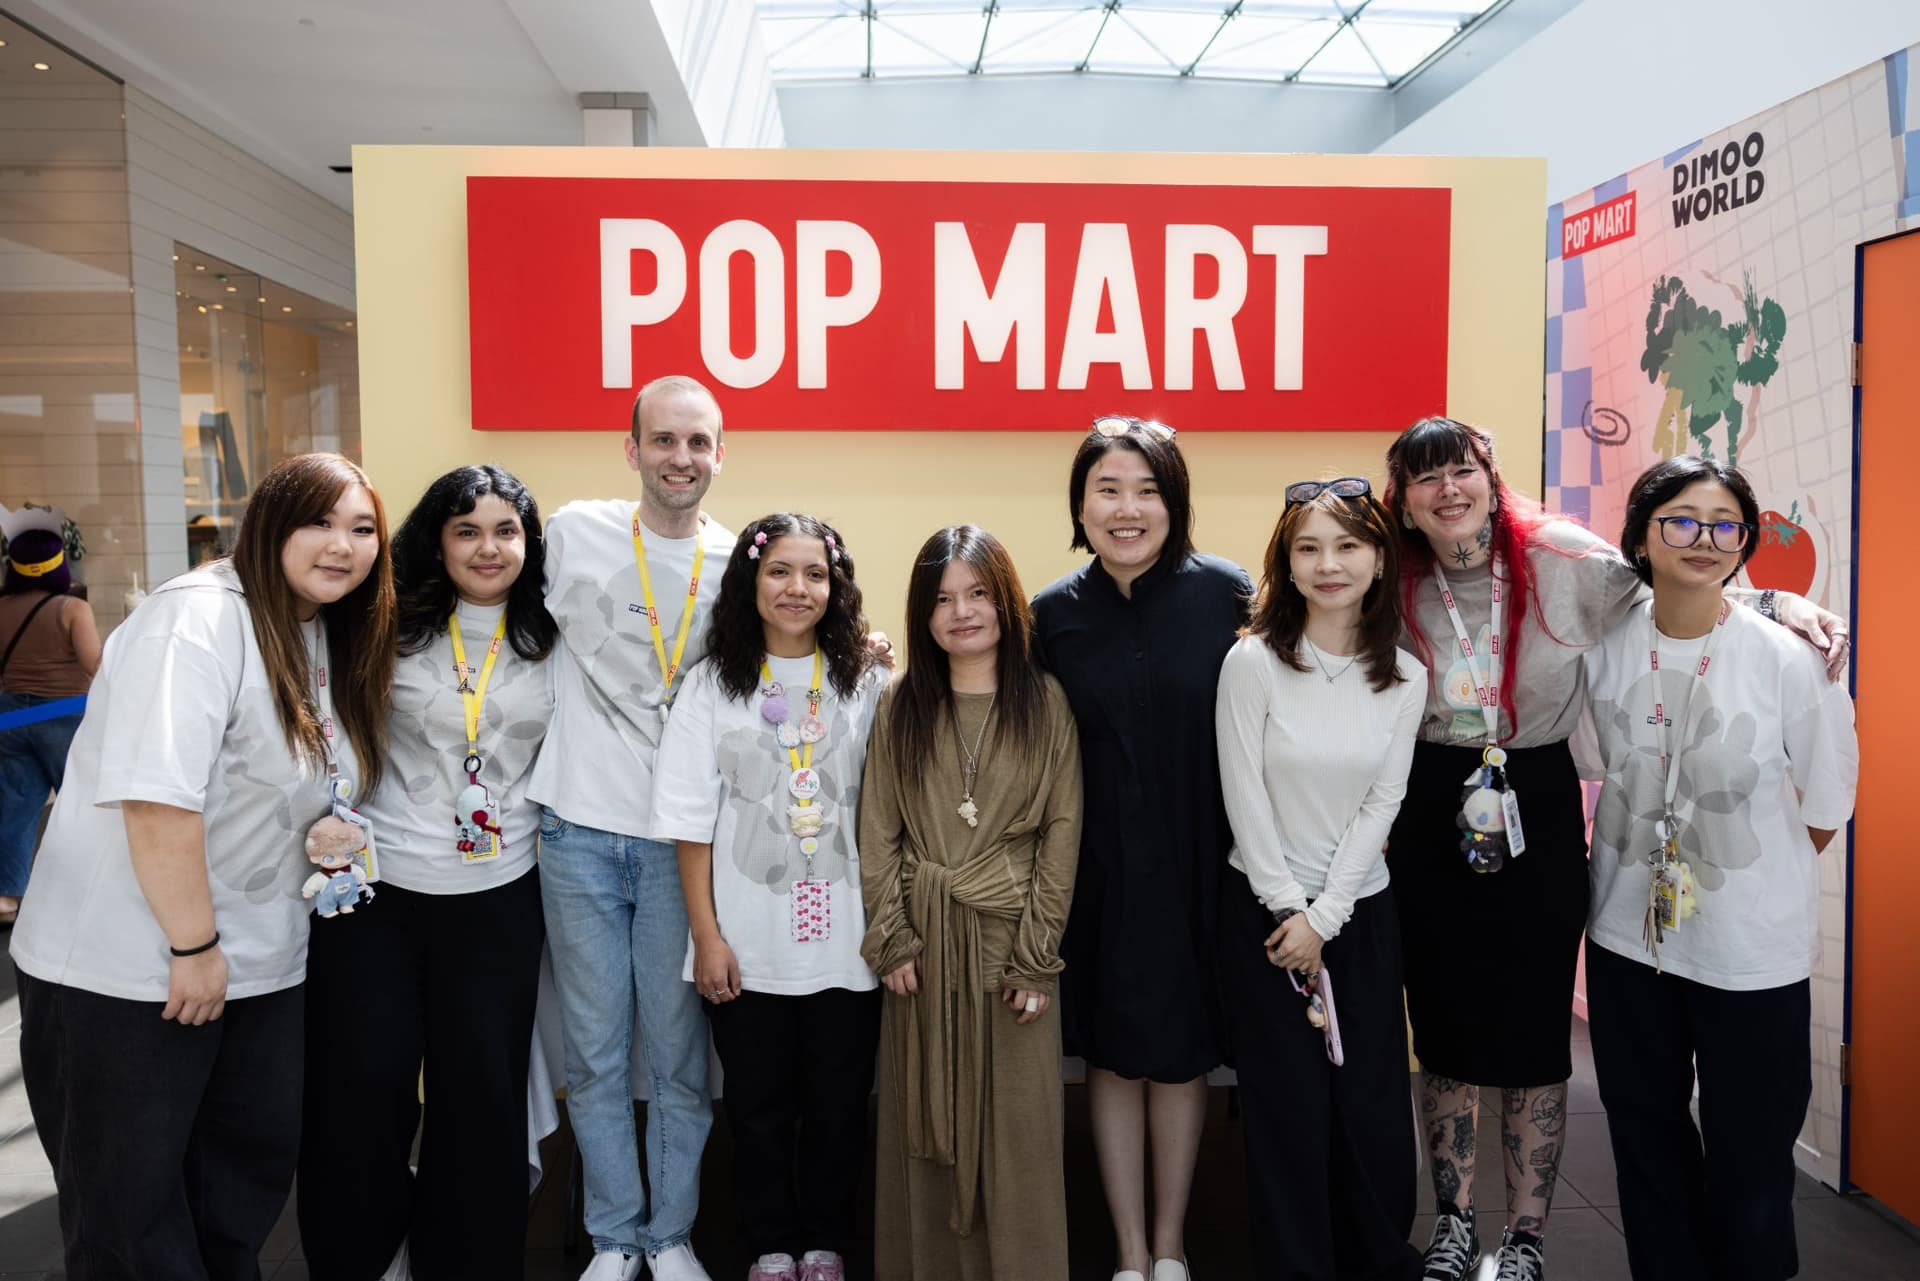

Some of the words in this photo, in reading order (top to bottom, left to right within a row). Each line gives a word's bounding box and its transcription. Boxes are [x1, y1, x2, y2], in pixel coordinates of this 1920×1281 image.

[1673, 131, 1764, 195] DIMOO
[1565, 216, 1590, 253] POP
[1593, 198, 1633, 243] MART
[1672, 170, 1764, 228] WORLD
[600, 218, 882, 389] POP
[934, 222, 1328, 391] MART
